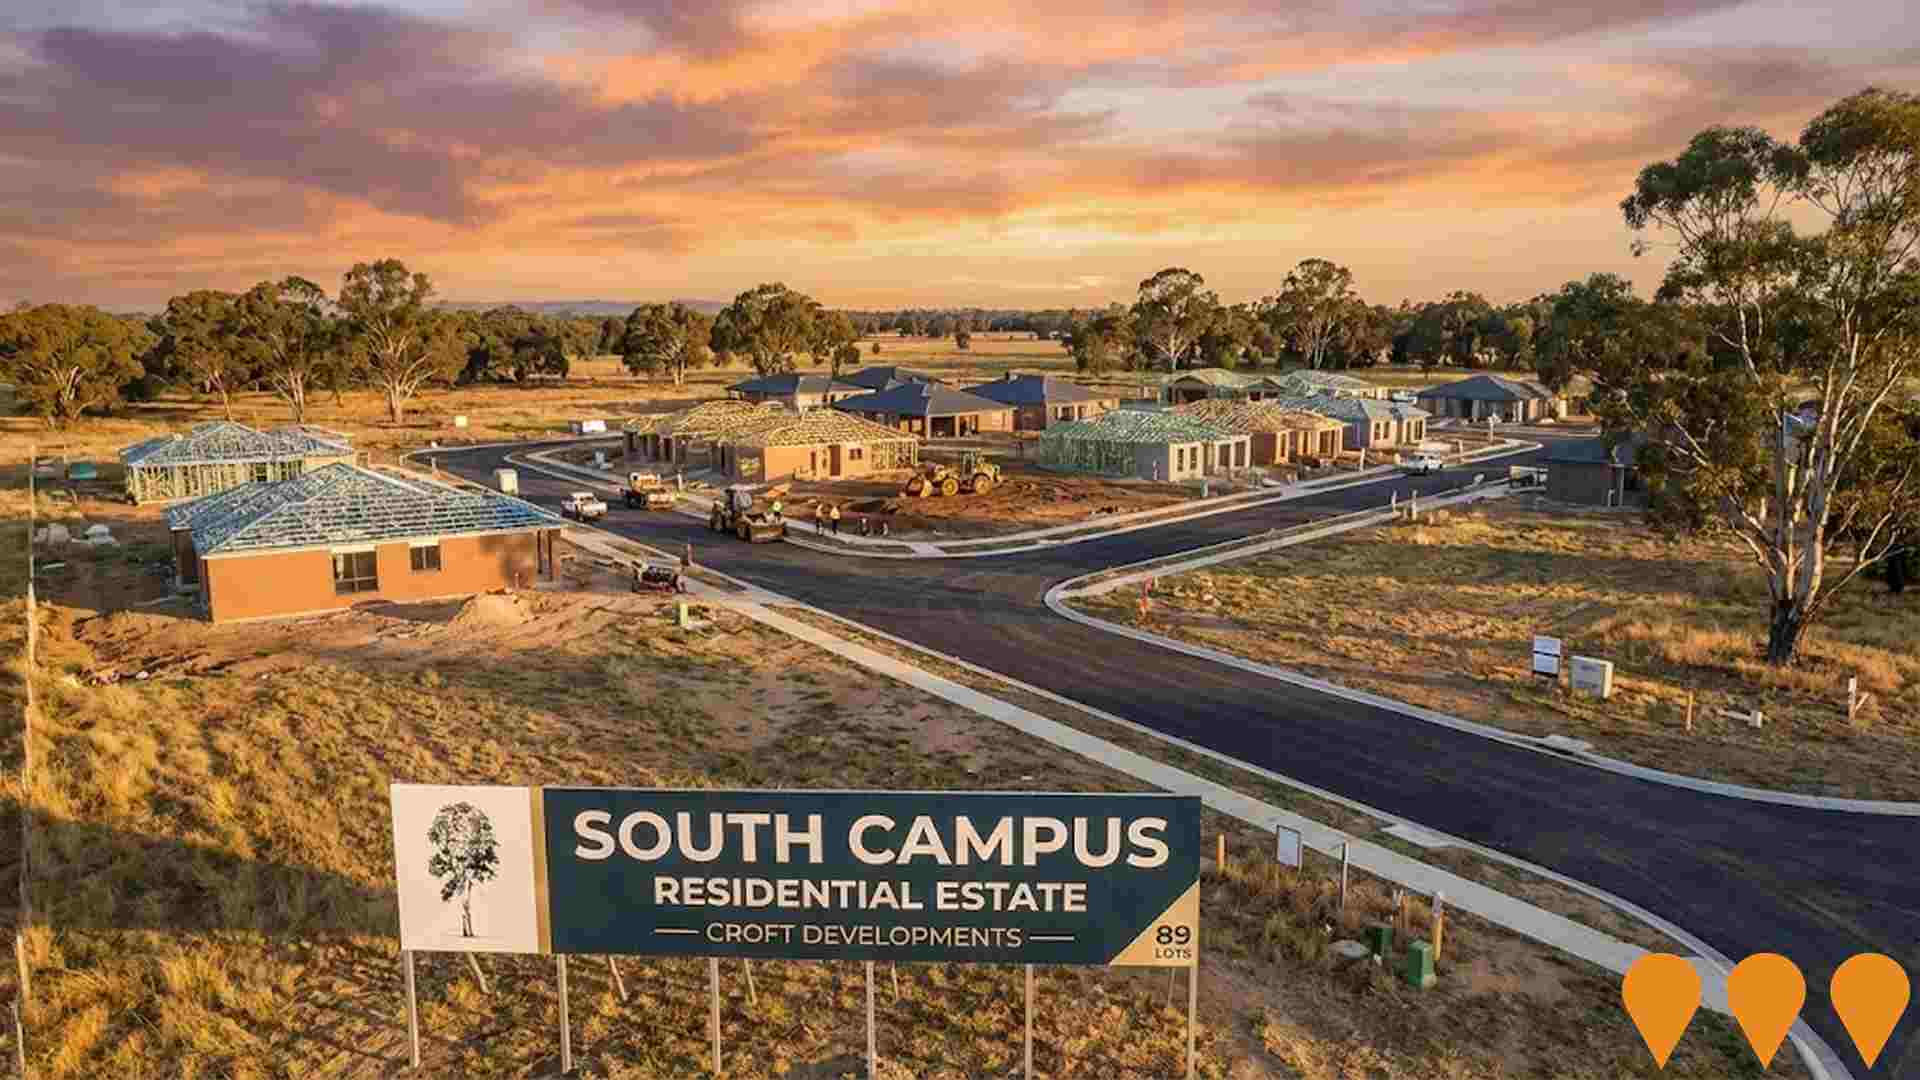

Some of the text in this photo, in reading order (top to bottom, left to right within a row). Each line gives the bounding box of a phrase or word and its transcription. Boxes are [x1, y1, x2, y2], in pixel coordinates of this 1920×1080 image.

[573, 810, 1170, 868] SOUTH CAMPUS
[655, 877, 1087, 912] RESIDENTIAL ESTATE
[707, 922, 1022, 948] CROFT DEVELOPMENTS
[1155, 924, 1191, 946] 89
[1155, 948, 1192, 960] LOTS
